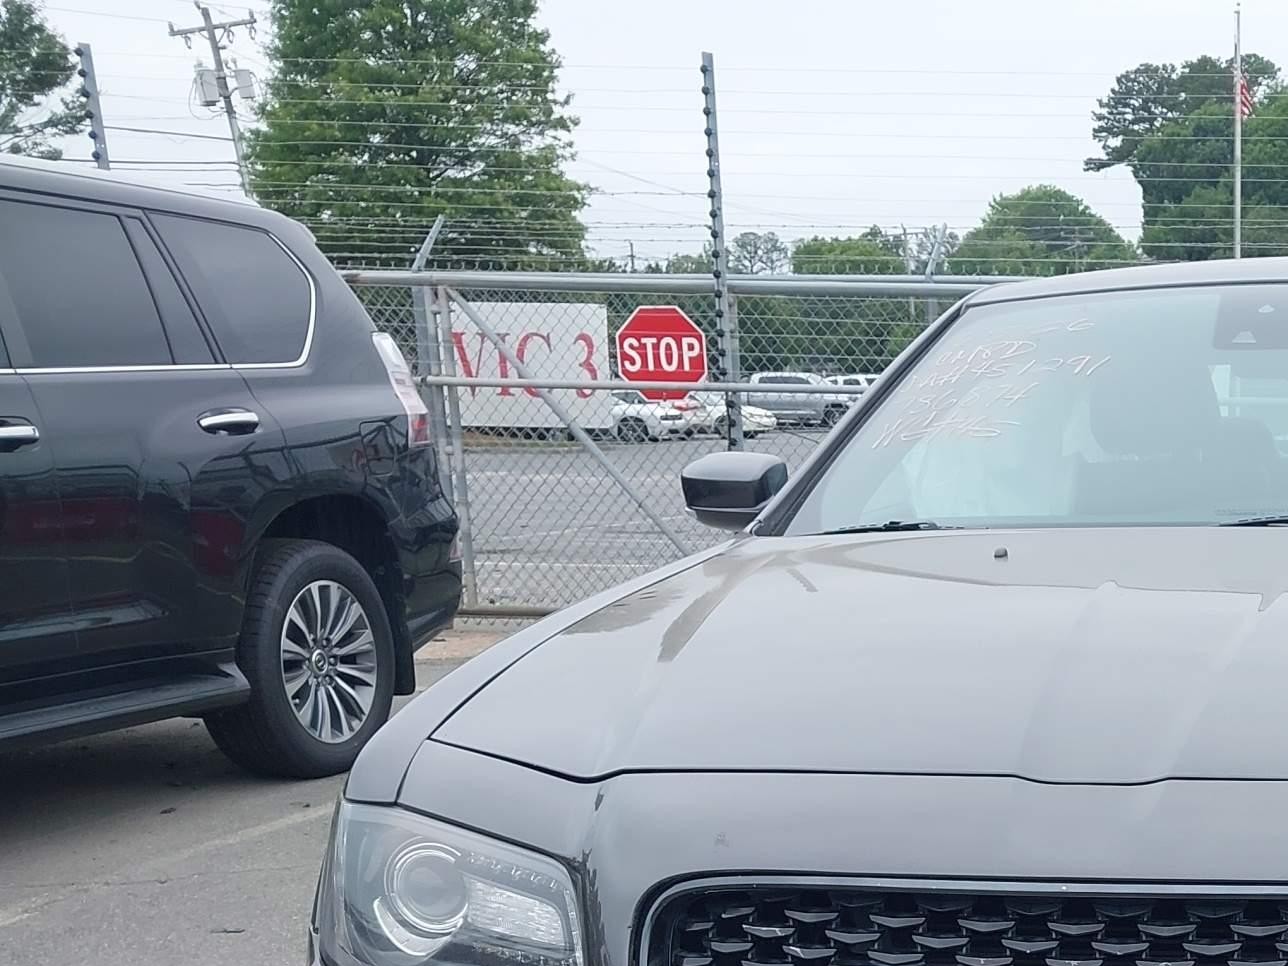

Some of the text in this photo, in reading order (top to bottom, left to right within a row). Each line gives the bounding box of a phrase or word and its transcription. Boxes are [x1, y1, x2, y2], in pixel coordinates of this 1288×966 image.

[451, 332, 599, 399] VIC 3
[623, 336, 700, 372] STOP
